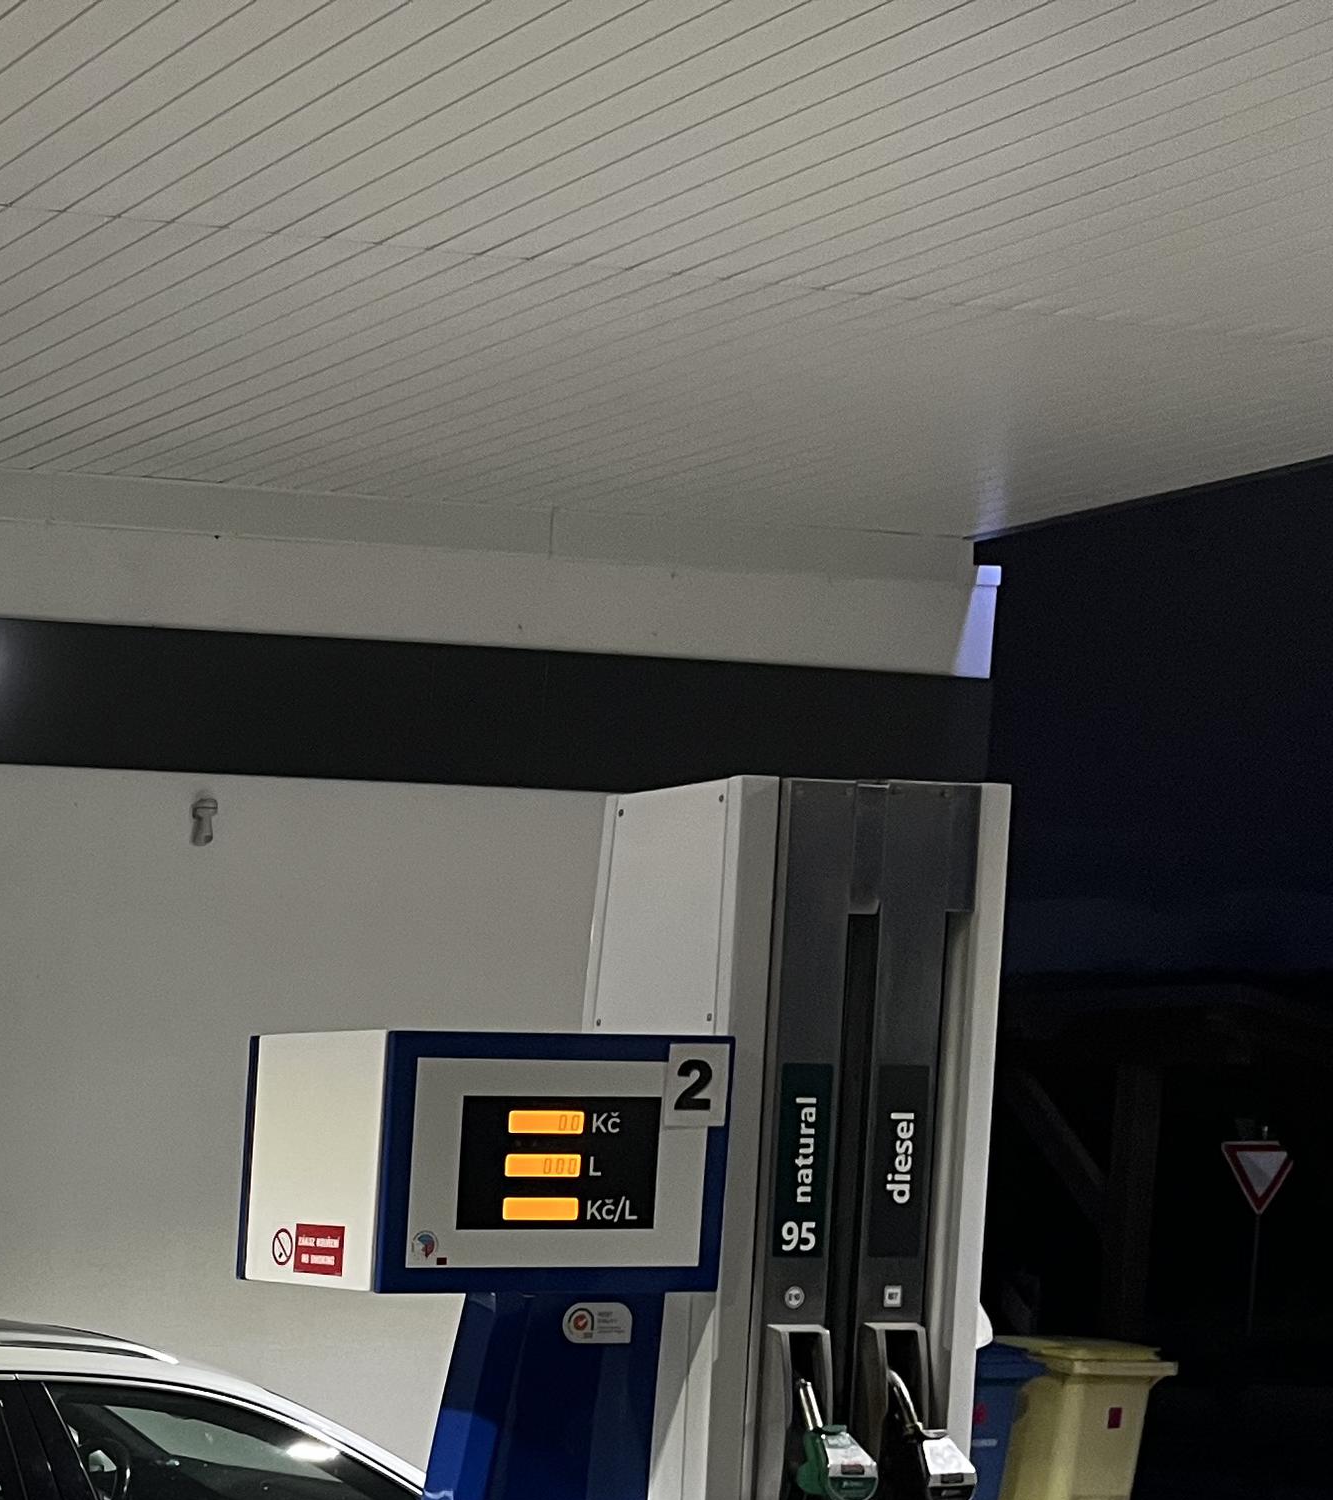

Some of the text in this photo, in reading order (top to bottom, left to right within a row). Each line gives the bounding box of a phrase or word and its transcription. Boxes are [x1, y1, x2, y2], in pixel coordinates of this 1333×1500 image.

[674, 1059, 713, 1111] 2
[592, 1111, 621, 1133] Kč
[588, 1155, 602, 1176] L
[794, 1097, 817, 1203] natural
[885, 1112, 915, 1204] diesel
[586, 1195, 638, 1223] Kč/L
[781, 1220, 817, 1252] 95
